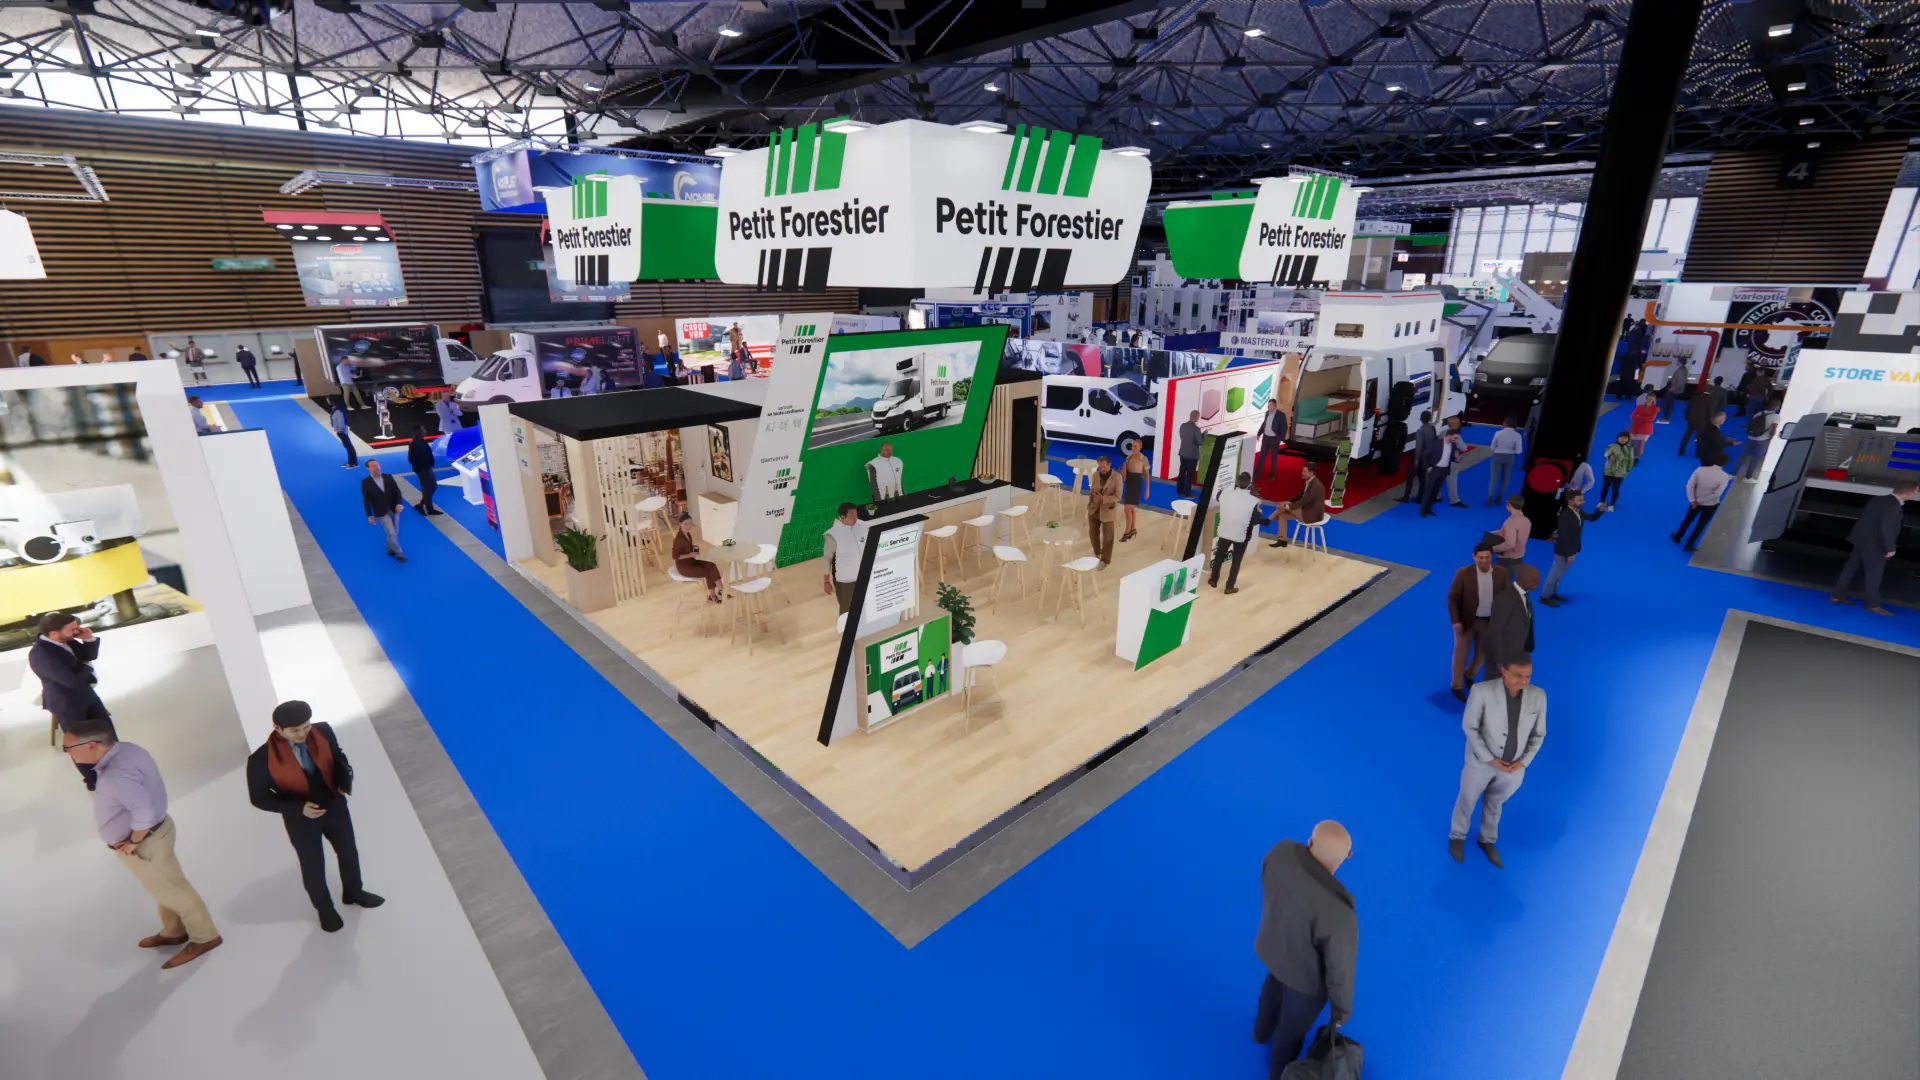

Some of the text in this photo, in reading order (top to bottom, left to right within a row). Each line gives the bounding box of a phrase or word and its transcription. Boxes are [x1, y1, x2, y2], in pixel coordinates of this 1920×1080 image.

[1787, 162, 1809, 180] 4
[729, 198, 889, 241] Petit Forestier
[936, 197, 1124, 241] Petit Forestier
[557, 222, 632, 250] Petit Forestier
[1259, 222, 1346, 249] Petit Forestier
[1734, 293, 1786, 302] varioptic
[1739, 301, 1792, 336] DVELOPPE
[683, 323, 708, 331] CARGO
[797, 336, 824, 344] Forestier
[1240, 336, 1290, 348] MASTERFLUX
[1824, 367, 1886, 382] STORE
[889, 536, 909, 546] Service
[885, 652, 896, 660] Petit
